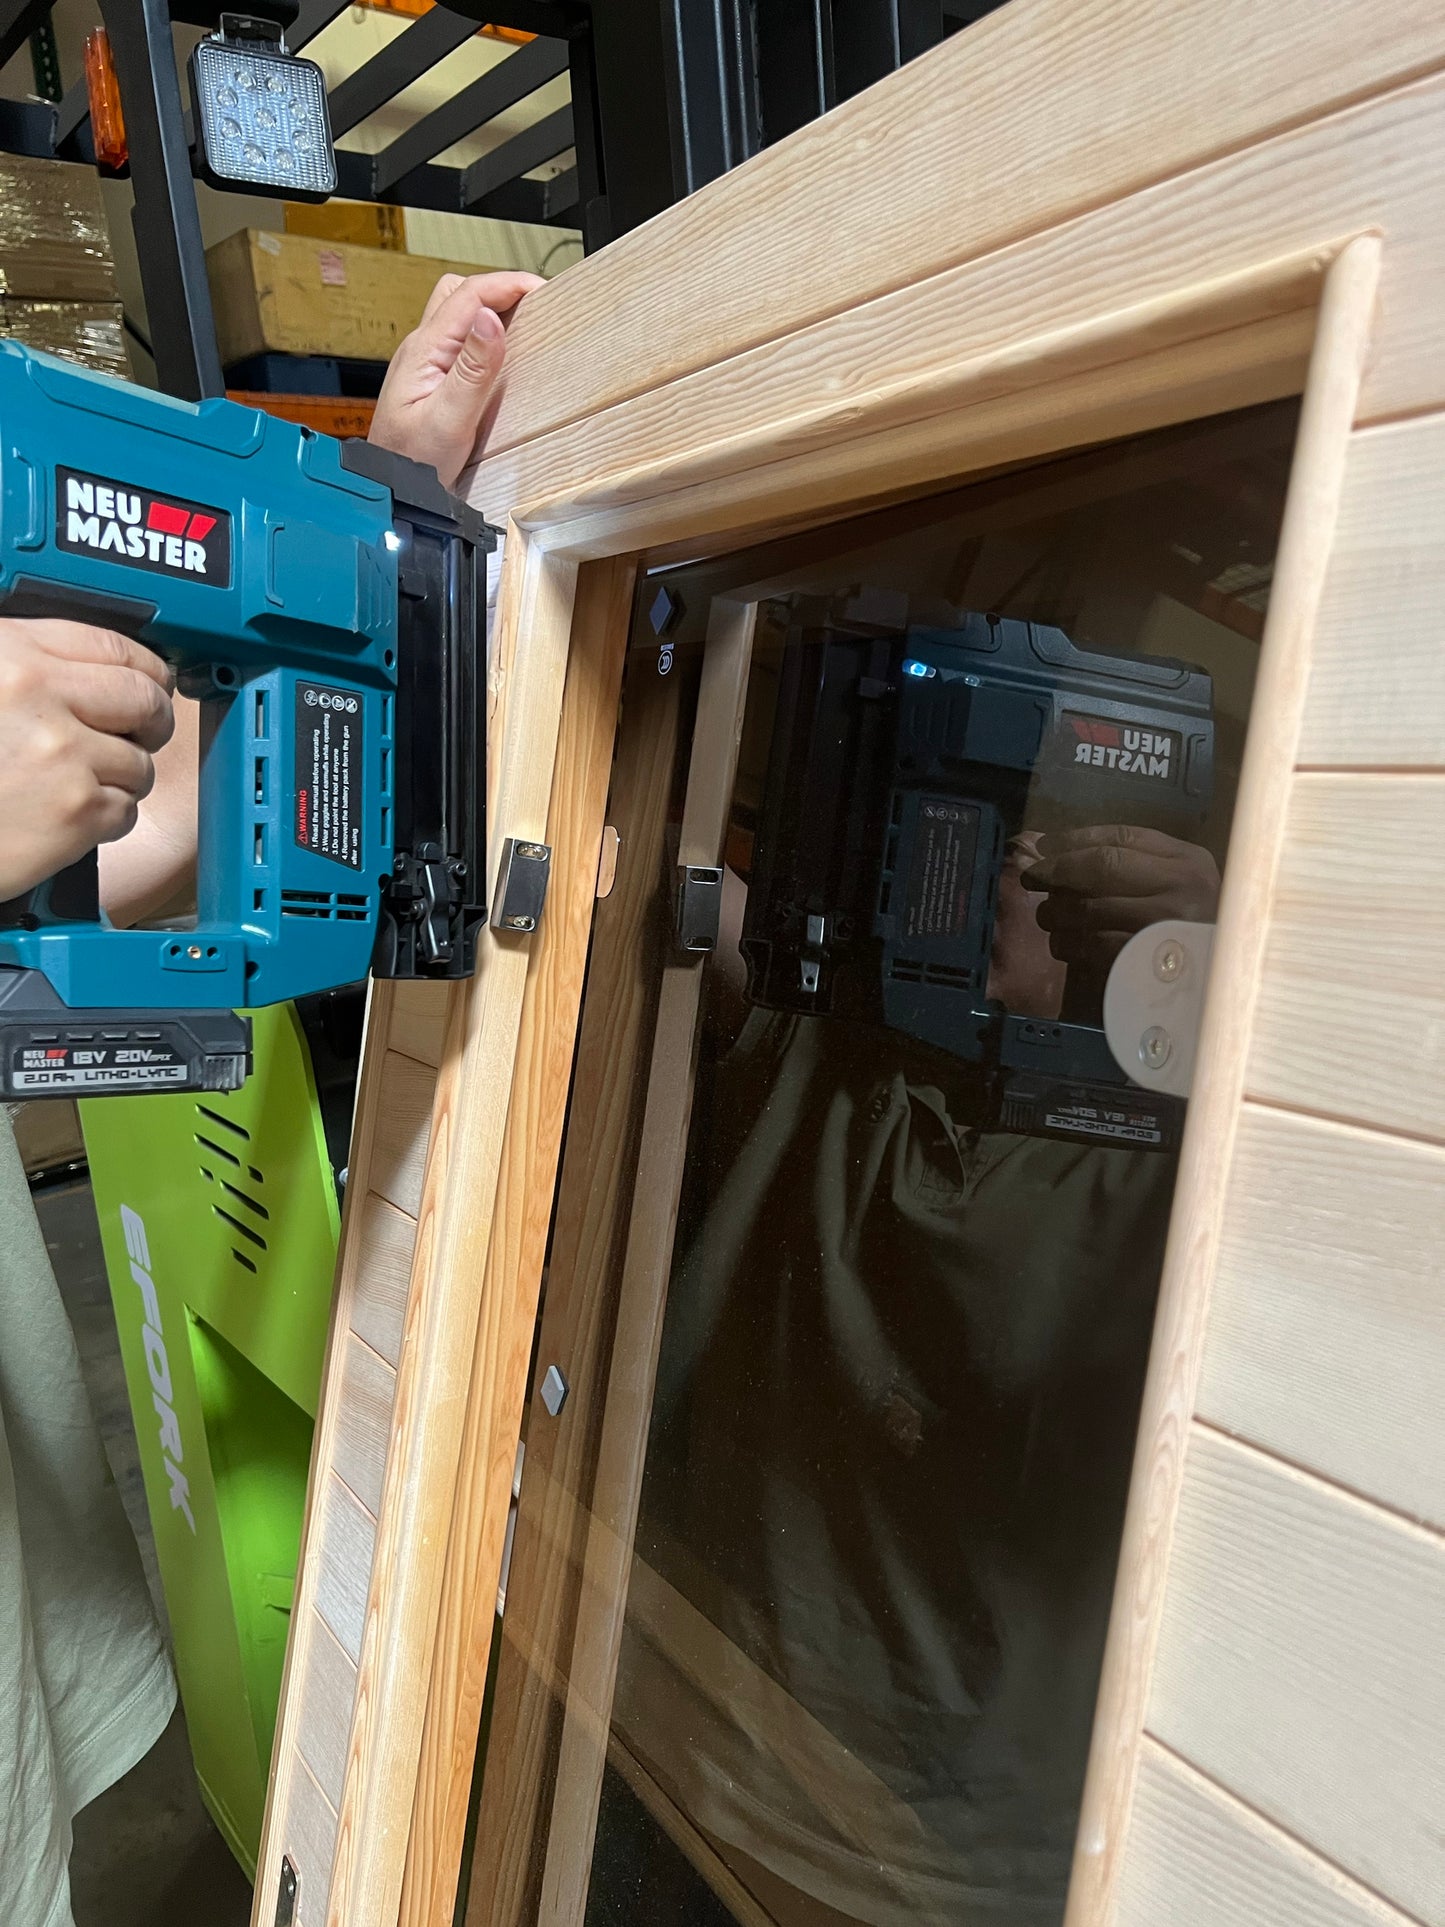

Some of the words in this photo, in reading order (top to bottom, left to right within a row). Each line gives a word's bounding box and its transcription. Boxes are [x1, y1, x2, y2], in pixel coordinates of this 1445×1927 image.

[67, 478, 141, 525] NEU
[67, 510, 207, 574] MASTER
[300, 790, 308, 832] WARNING
[23, 1050, 45, 1059] NEU
[23, 1059, 65, 1068] MASTER
[73, 1051, 107, 1064] 18V
[85, 1068, 178, 1080] LITHO-LYNC
[120, 1203, 197, 1536] EFORK
